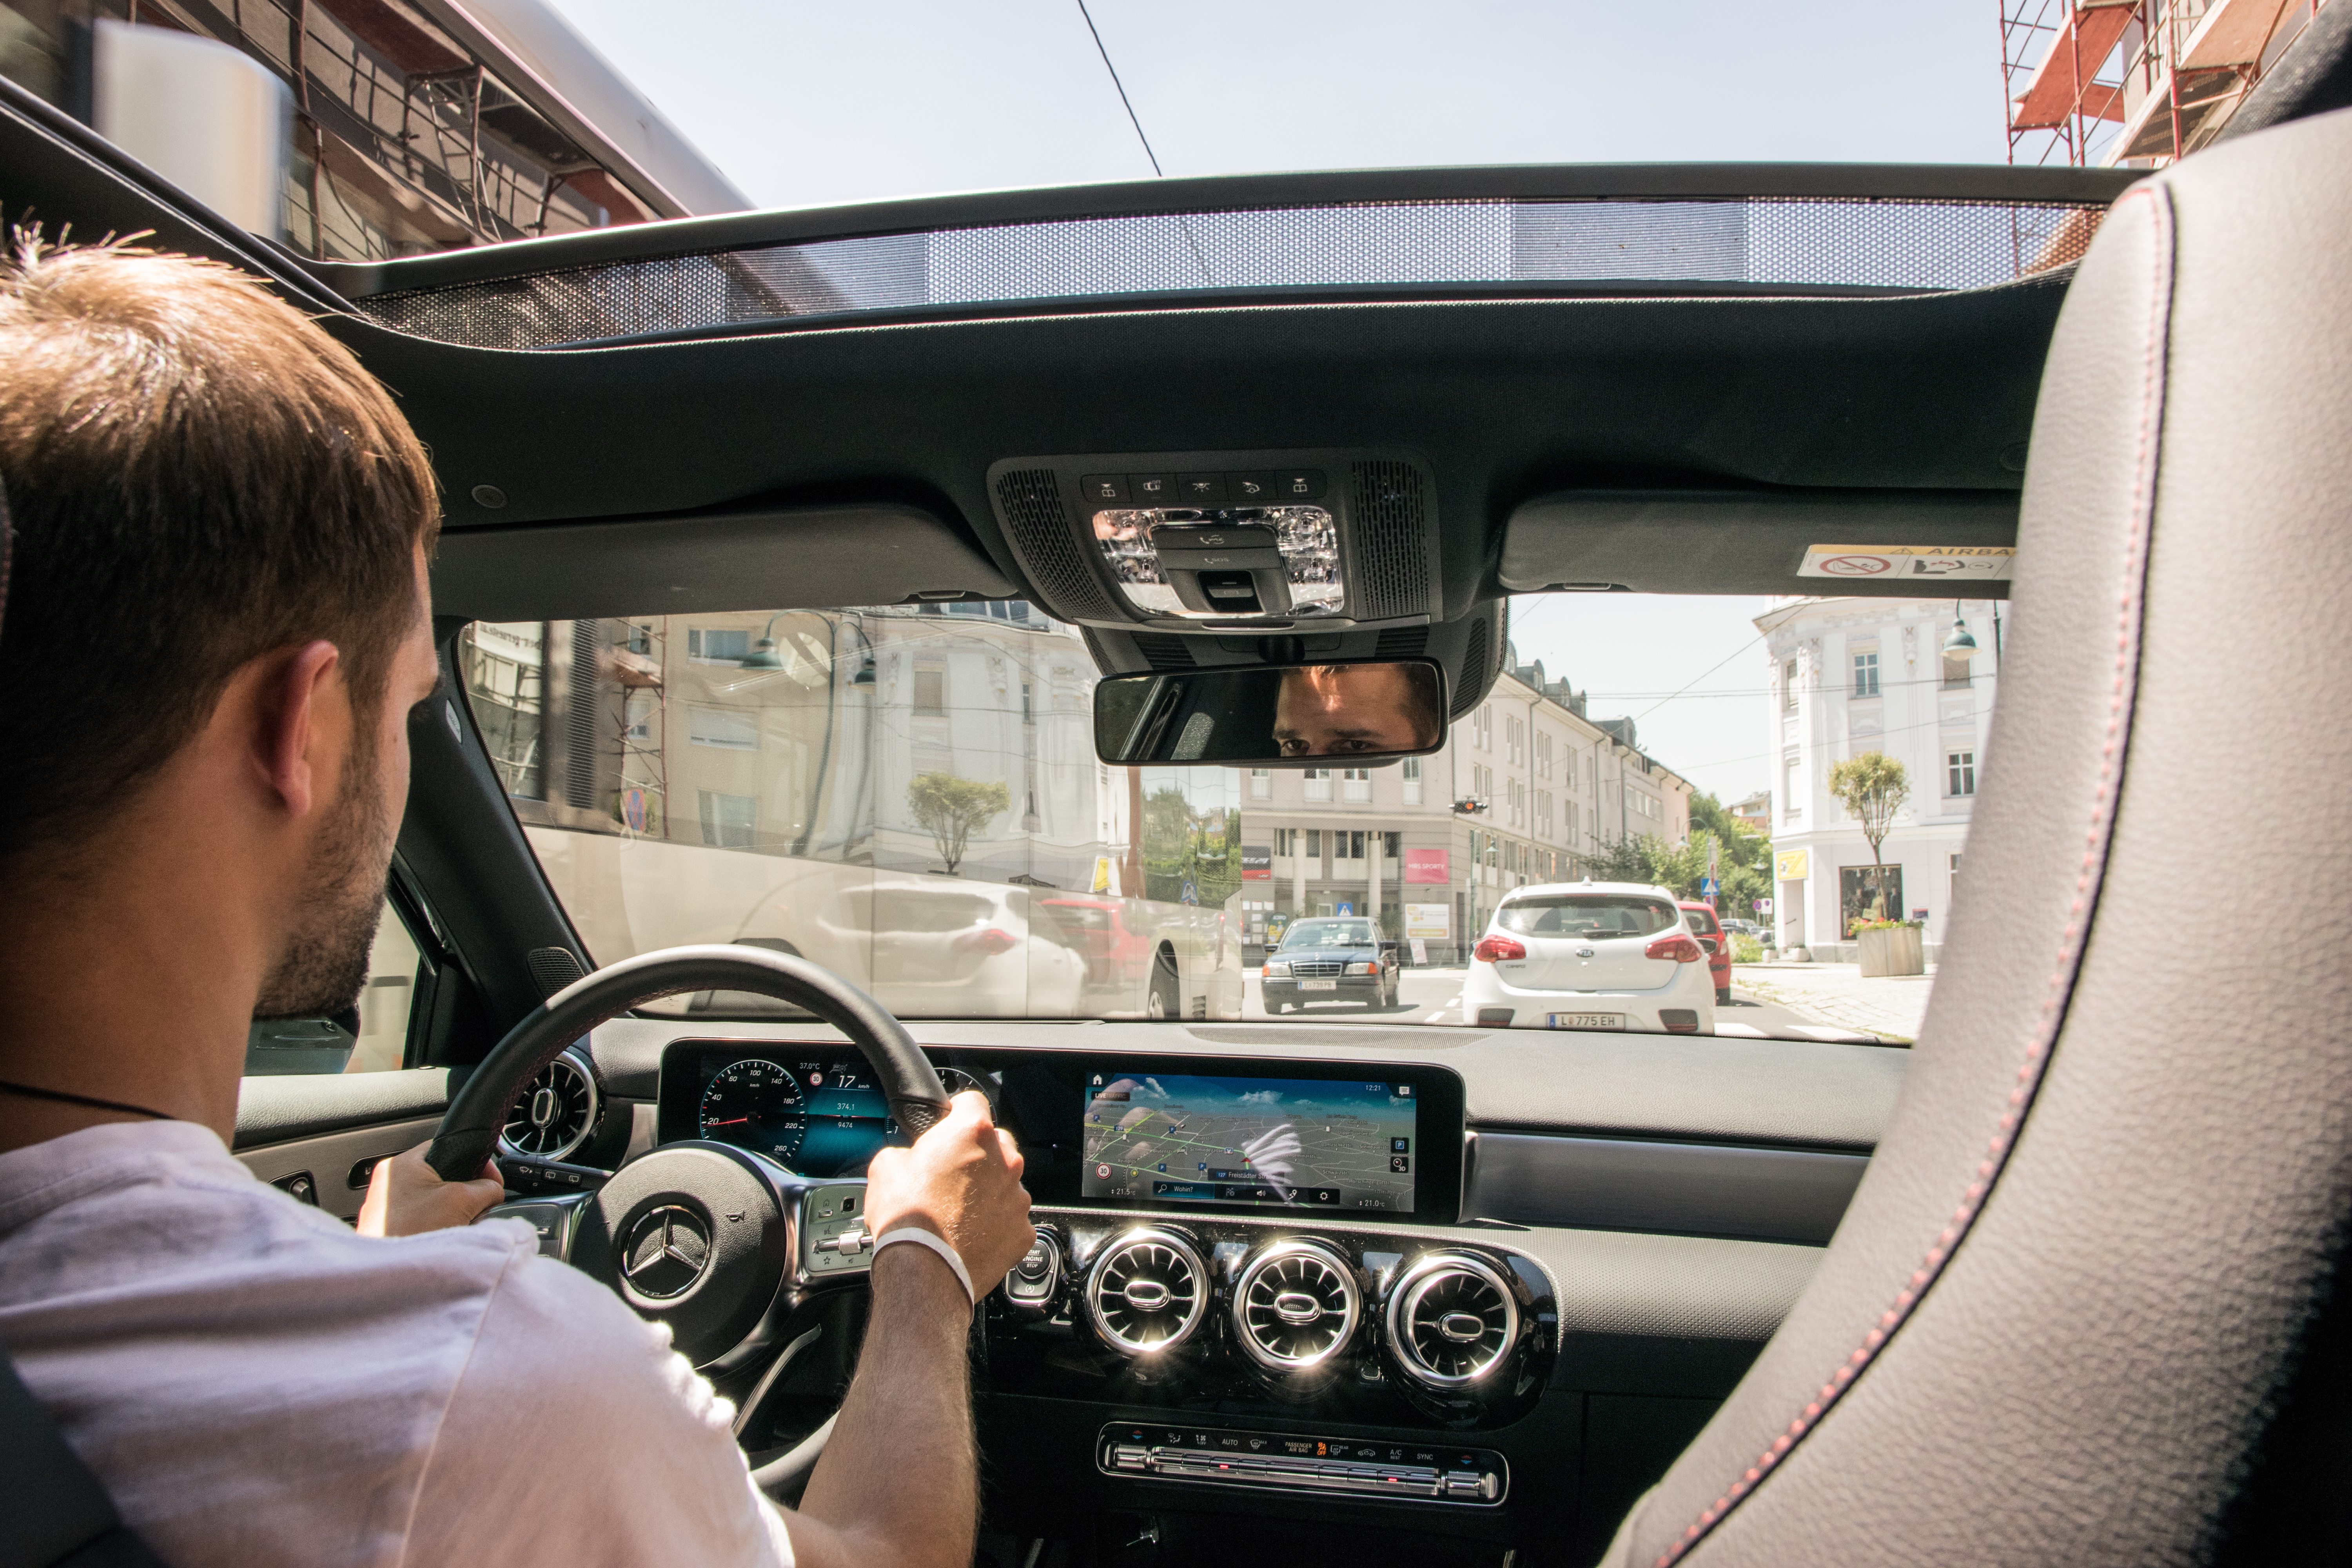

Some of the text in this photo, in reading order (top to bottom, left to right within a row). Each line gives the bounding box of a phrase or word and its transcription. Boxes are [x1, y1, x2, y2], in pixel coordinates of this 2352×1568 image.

[1561, 1016, 1615, 1025] L 775 EH
[839, 1075, 856, 1088] 17
